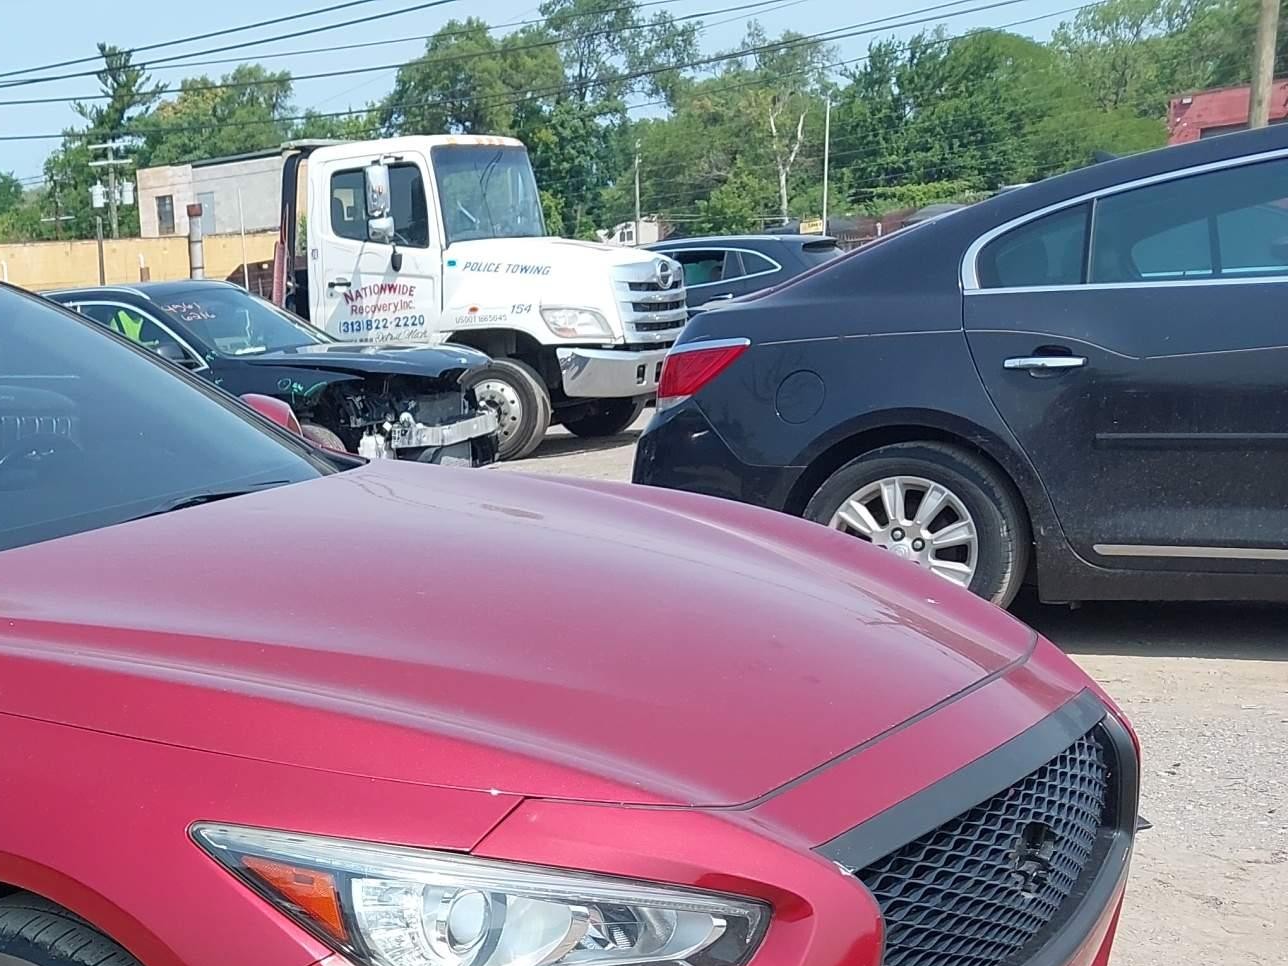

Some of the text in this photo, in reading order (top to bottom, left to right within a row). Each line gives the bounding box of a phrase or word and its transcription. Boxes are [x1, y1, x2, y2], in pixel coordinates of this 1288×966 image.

[462, 261, 551, 276] POLICE TOWING
[343, 283, 416, 304] NATIONWIDE
[510, 303, 532, 314] 154
